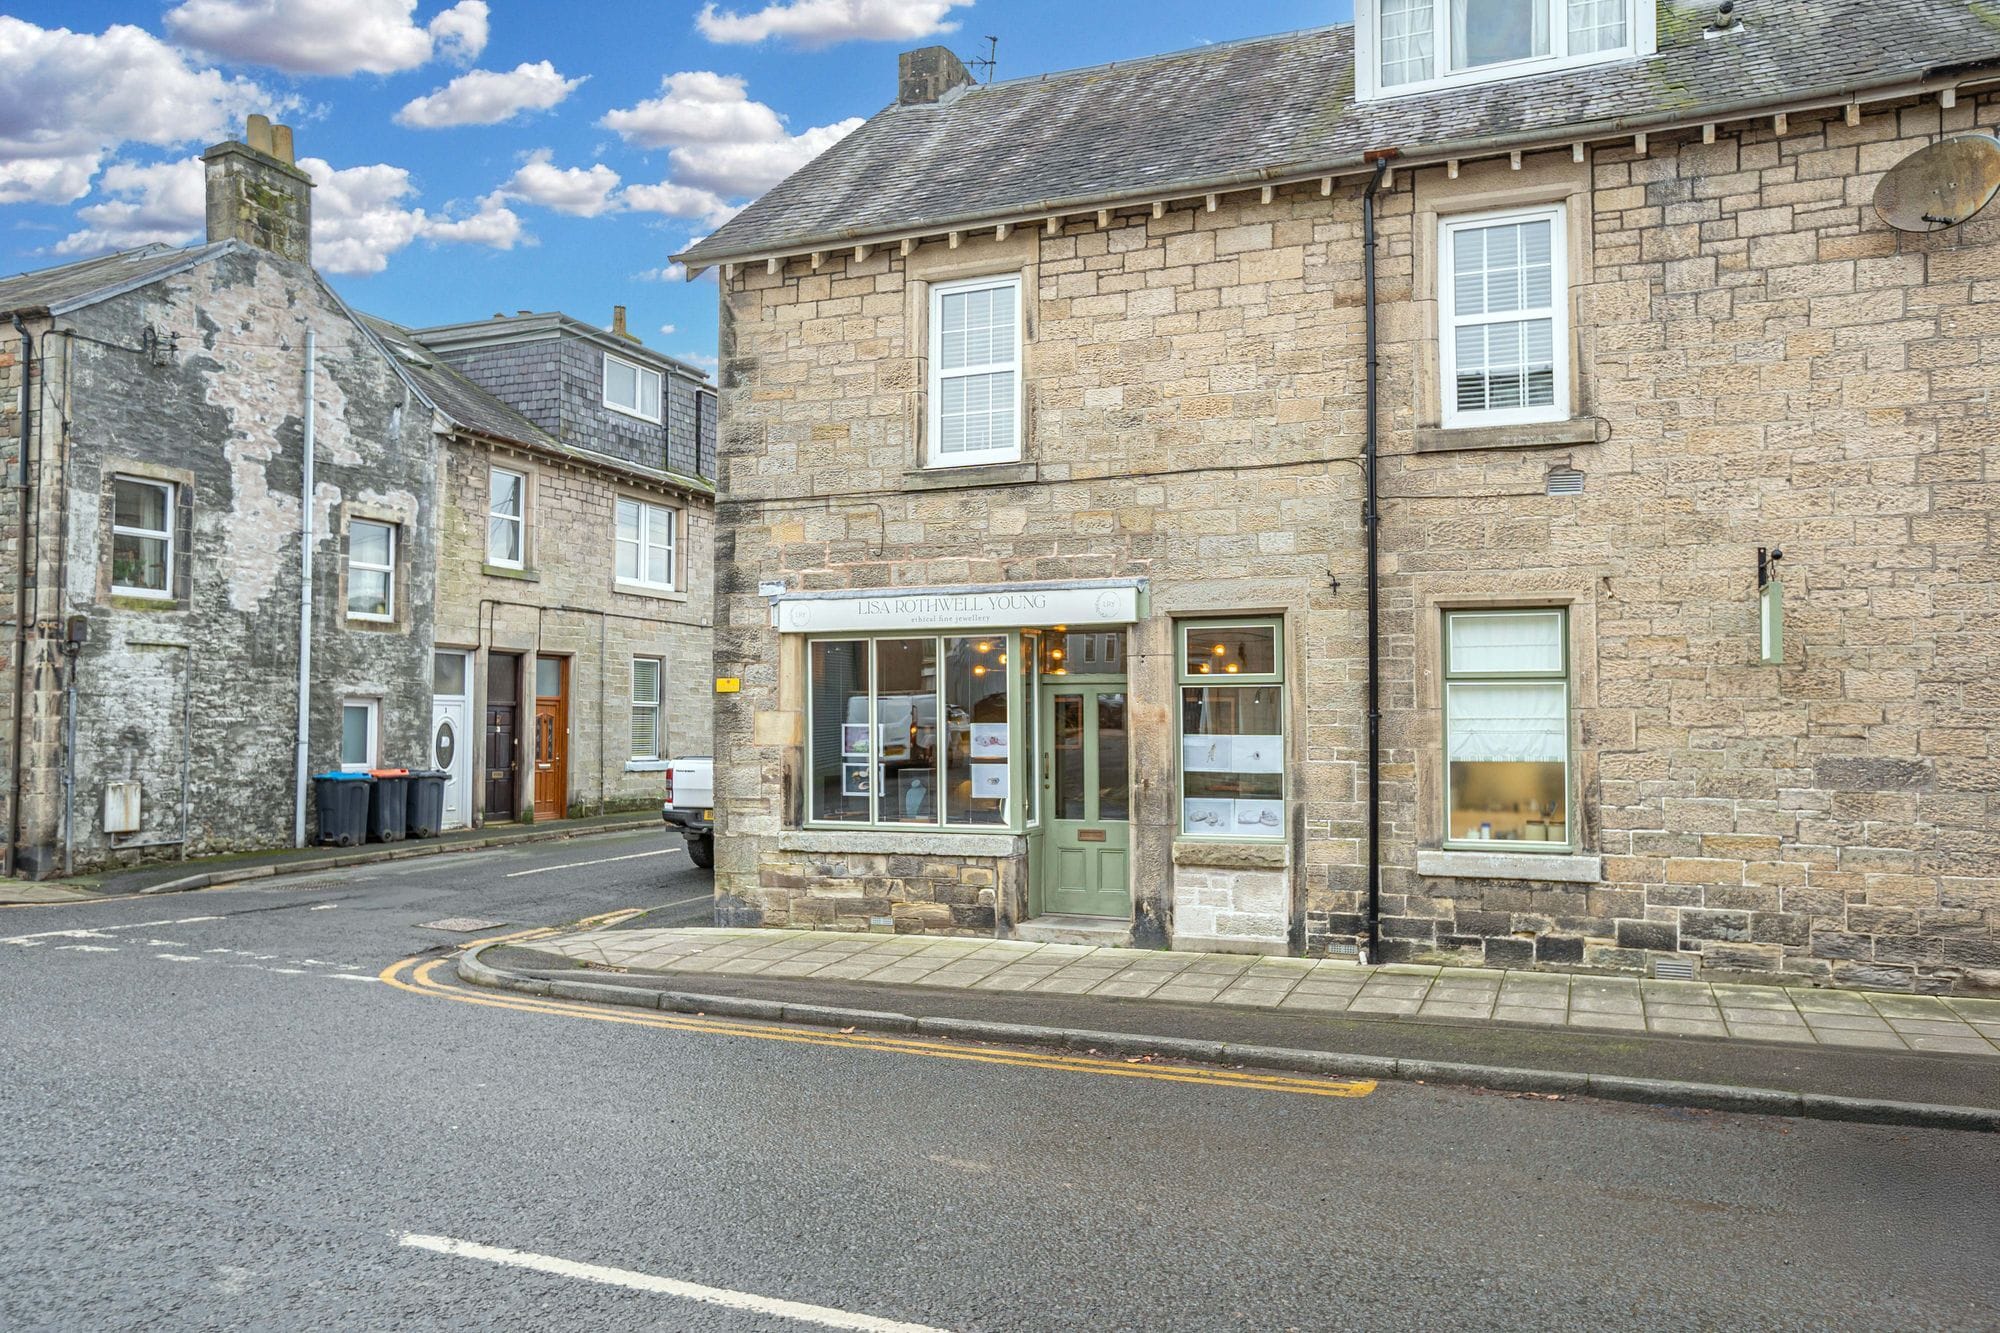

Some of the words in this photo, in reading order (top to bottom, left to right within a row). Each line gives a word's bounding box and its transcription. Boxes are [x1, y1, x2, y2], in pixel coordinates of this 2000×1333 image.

[858, 600, 890, 615] LISA
[895, 597, 983, 614] ROTHWELL
[988, 595, 1046, 610] YOUNG
[911, 615, 936, 623] ethical
[955, 614, 991, 624] jewellery
